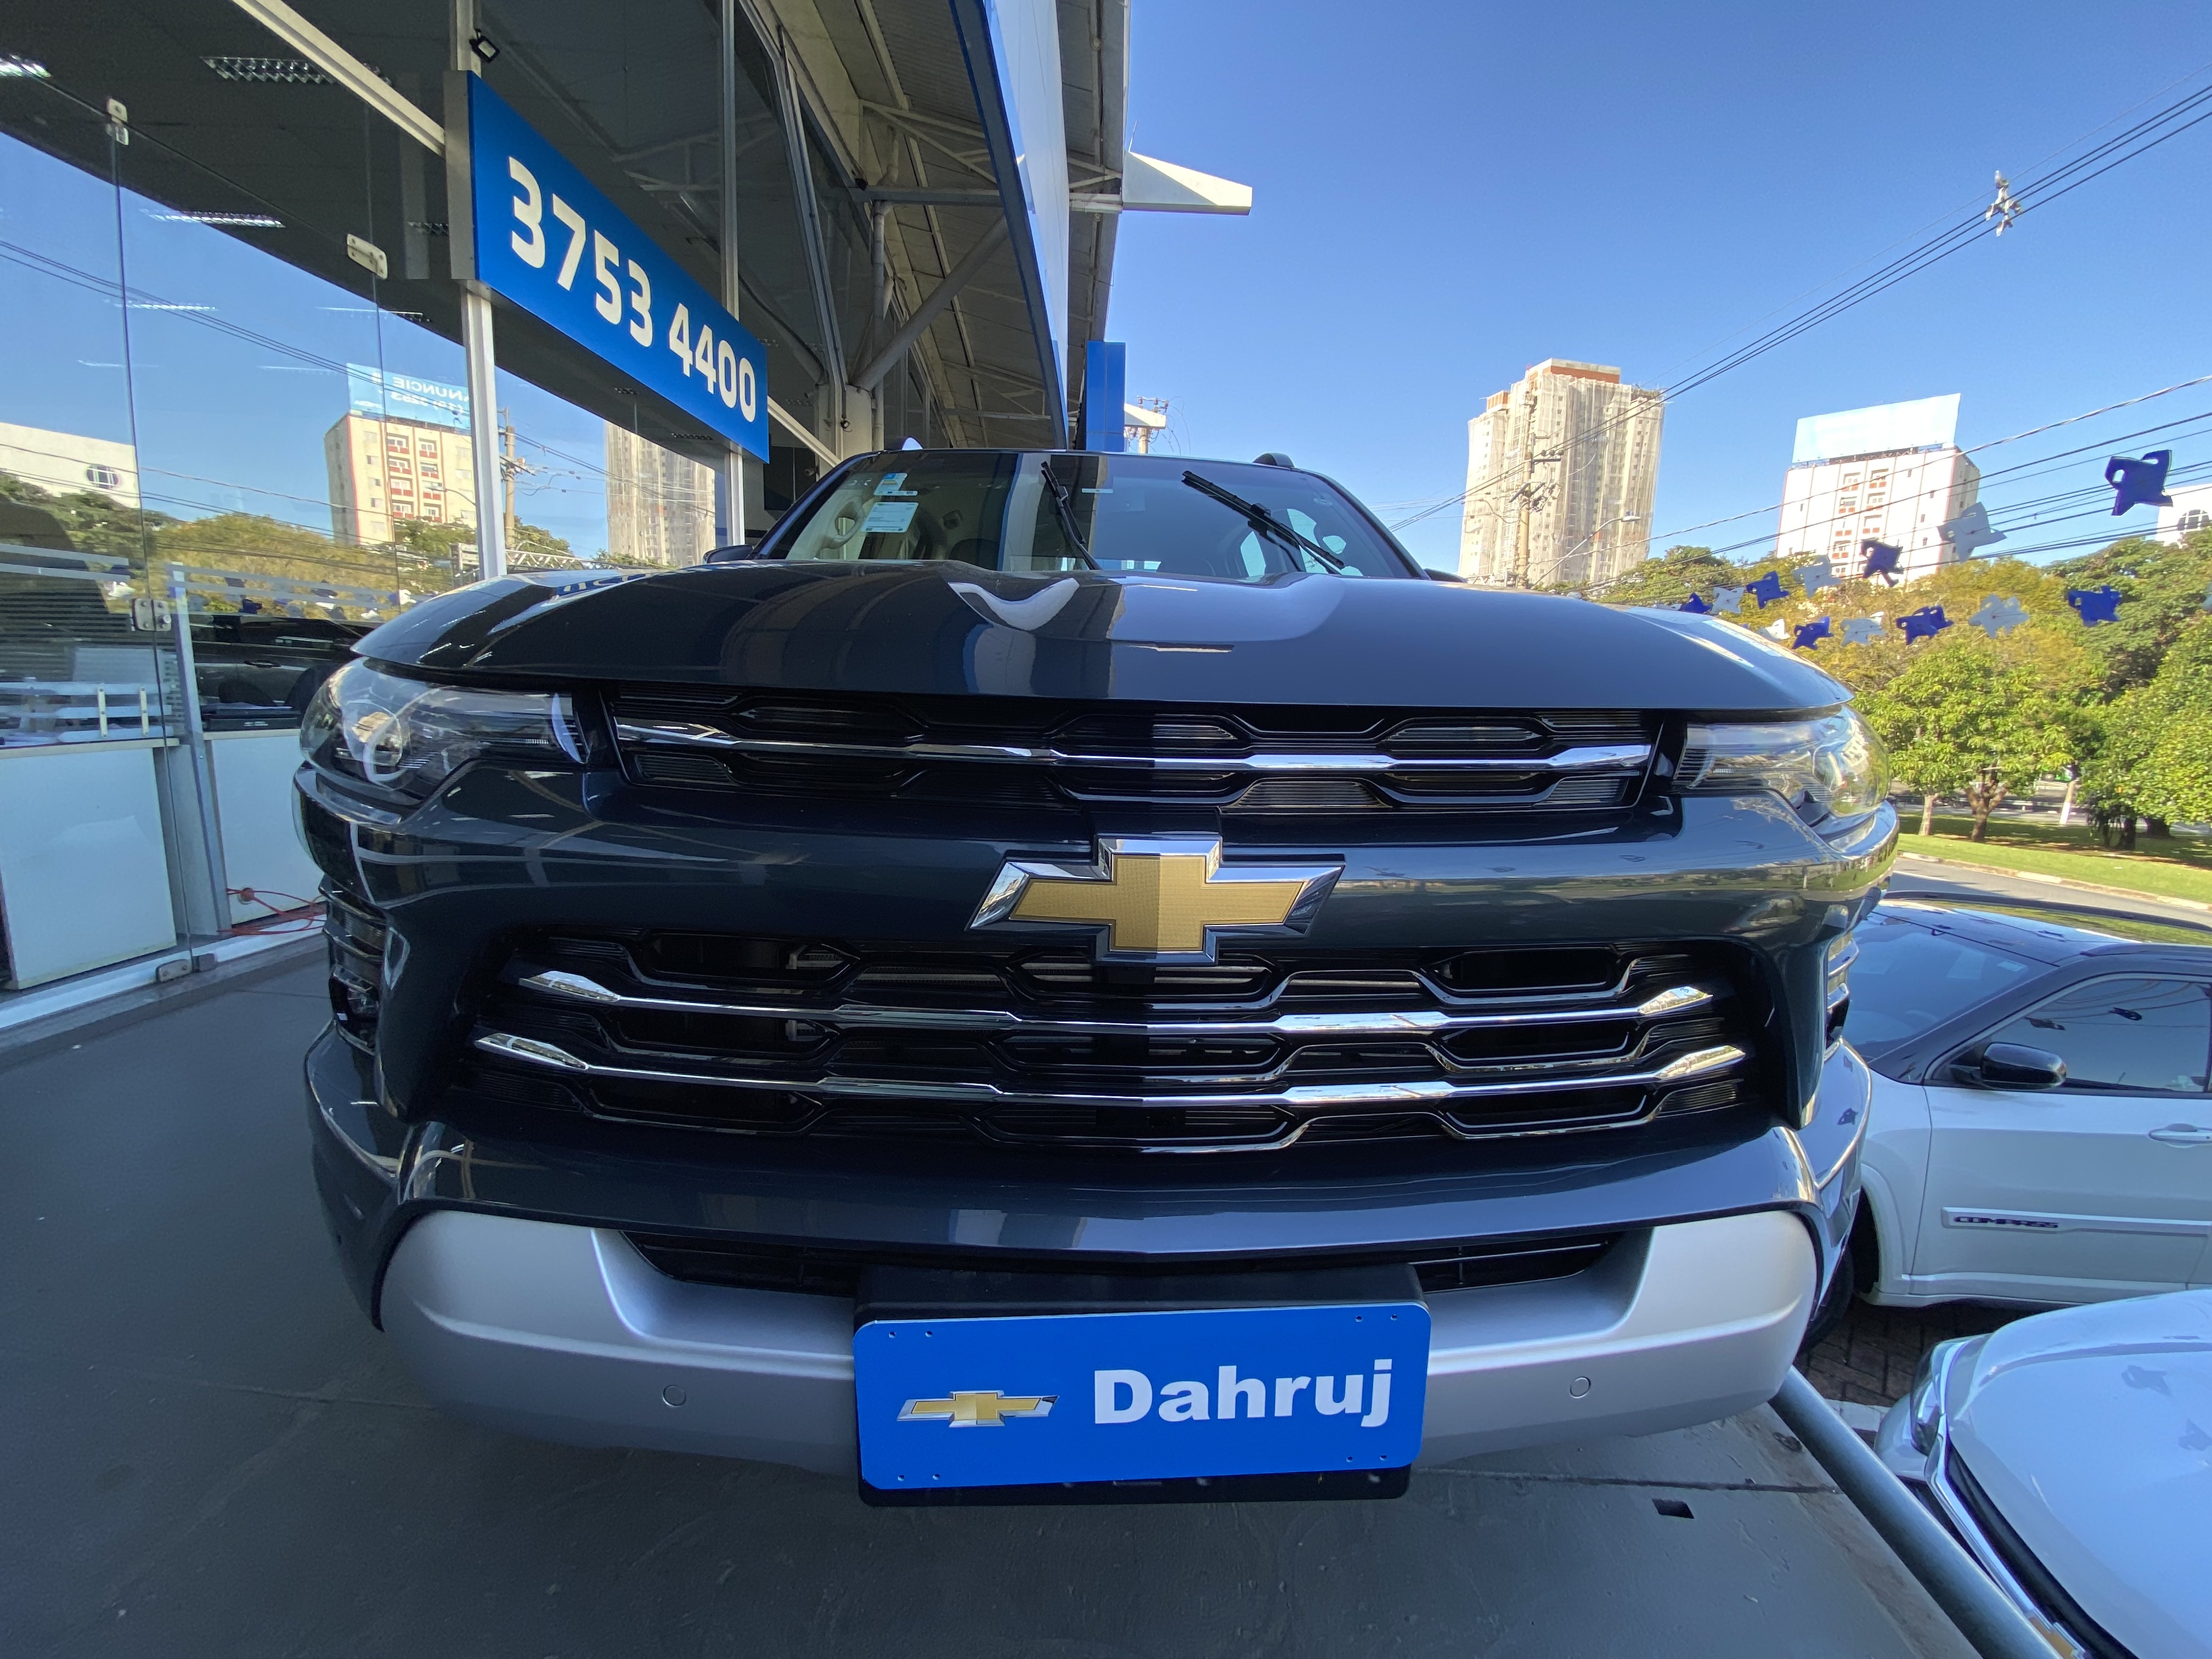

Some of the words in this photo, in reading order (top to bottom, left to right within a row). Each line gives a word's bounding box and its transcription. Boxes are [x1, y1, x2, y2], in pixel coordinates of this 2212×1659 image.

[509, 156, 653, 348] 3753
[669, 302, 756, 422] 4400
[1094, 1358, 1392, 1427] Dahruj
